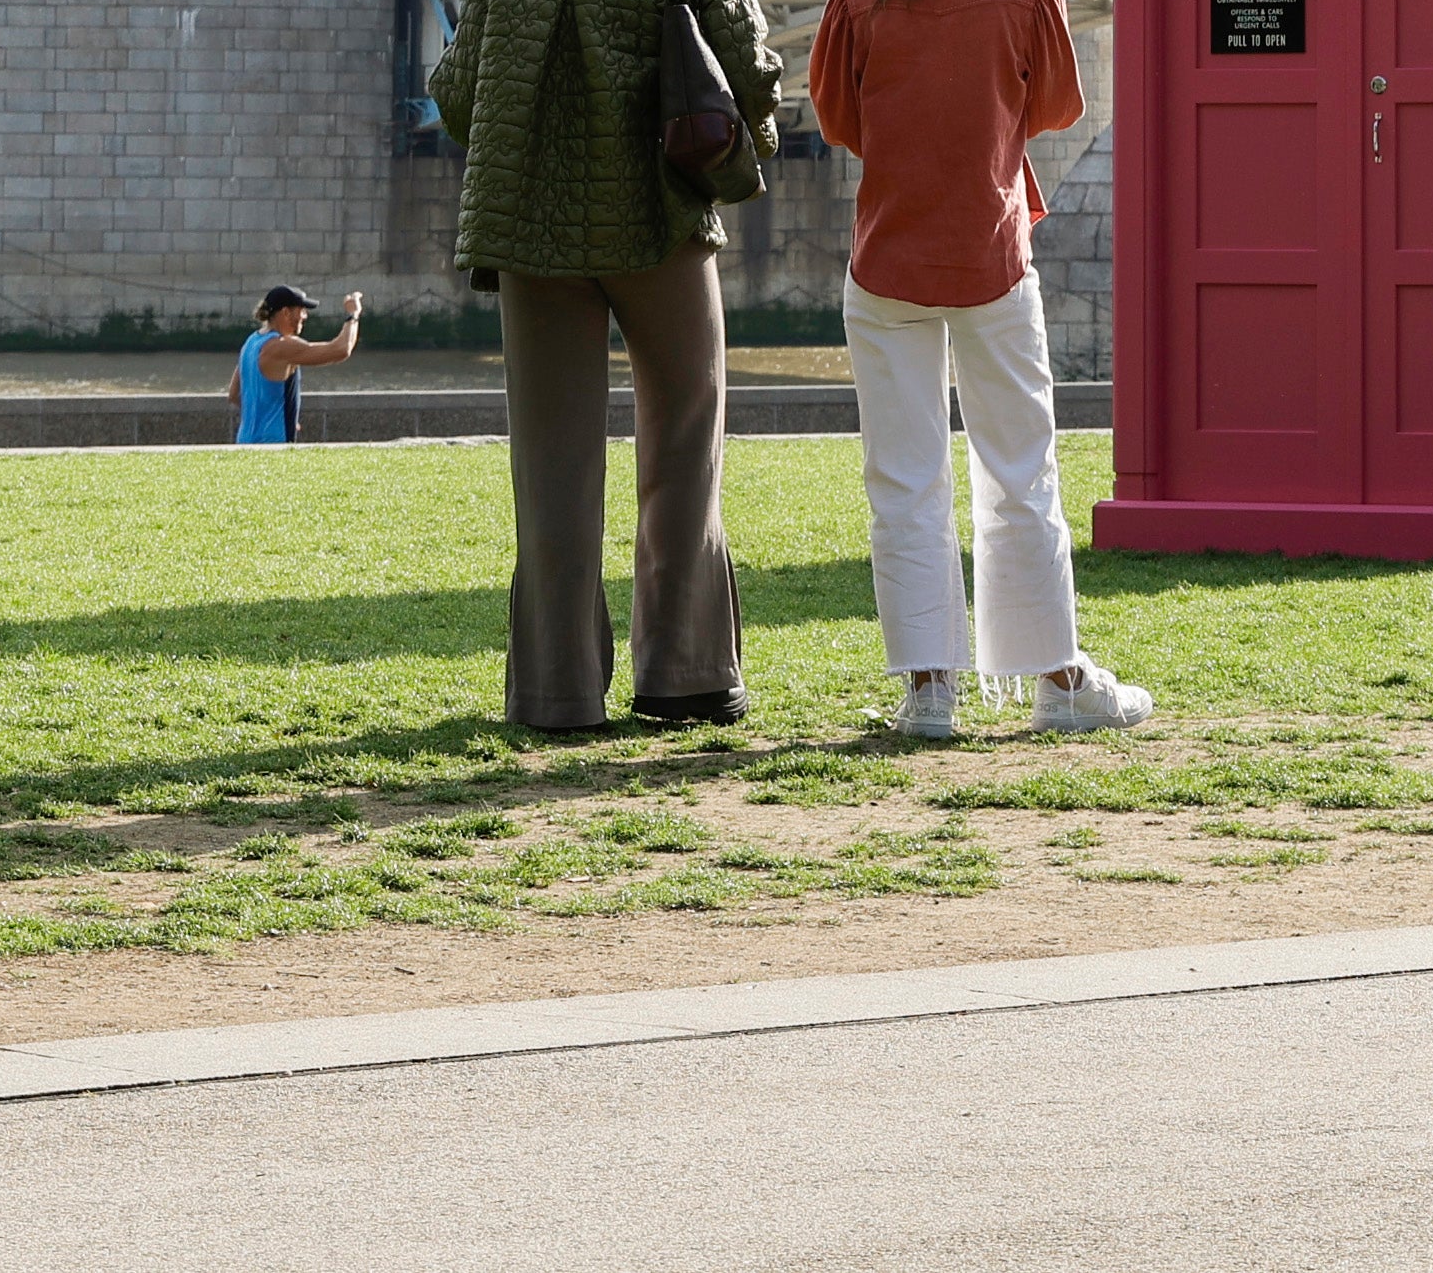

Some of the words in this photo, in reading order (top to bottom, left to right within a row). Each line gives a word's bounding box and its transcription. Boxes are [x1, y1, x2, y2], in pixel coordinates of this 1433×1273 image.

[1228, 35, 1247, 47] PULL
[1251, 35, 1261, 47] TO
[1265, 34, 1286, 47] OPEN
